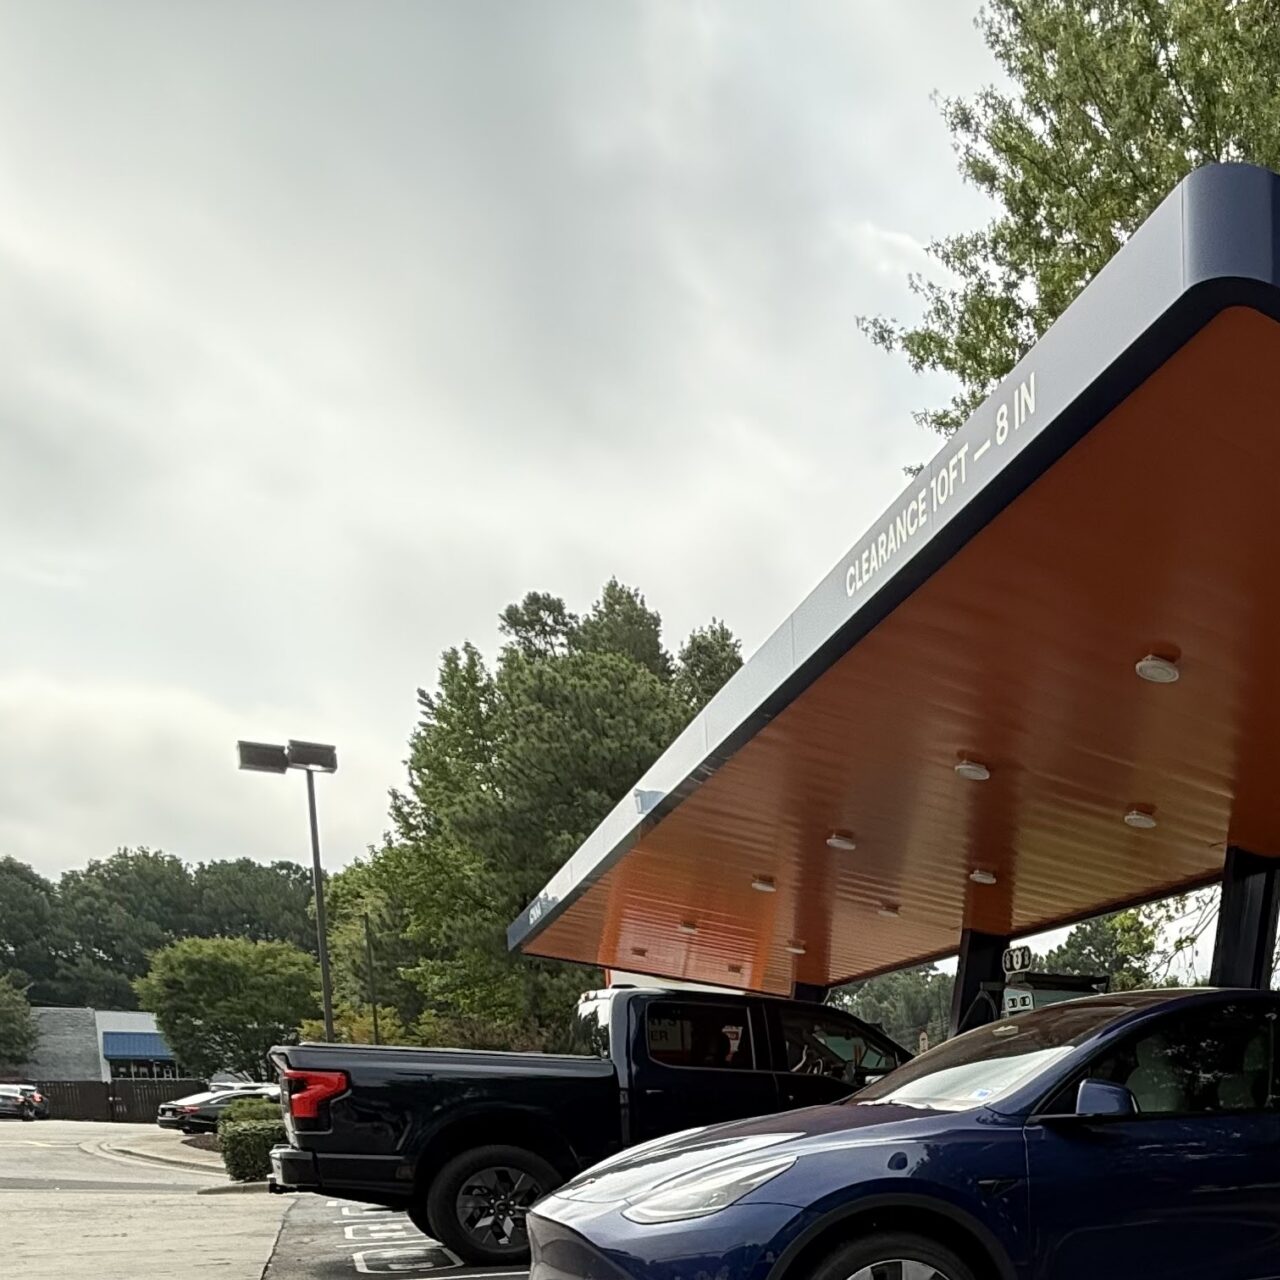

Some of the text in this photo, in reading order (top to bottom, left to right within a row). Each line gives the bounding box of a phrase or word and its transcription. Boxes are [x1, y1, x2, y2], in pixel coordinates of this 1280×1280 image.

[845, 487, 928, 597] CLEARANCE
[930, 443, 969, 512] 10FT
[995, 403, 1009, 446] 8
[1014, 371, 1036, 431] IN
